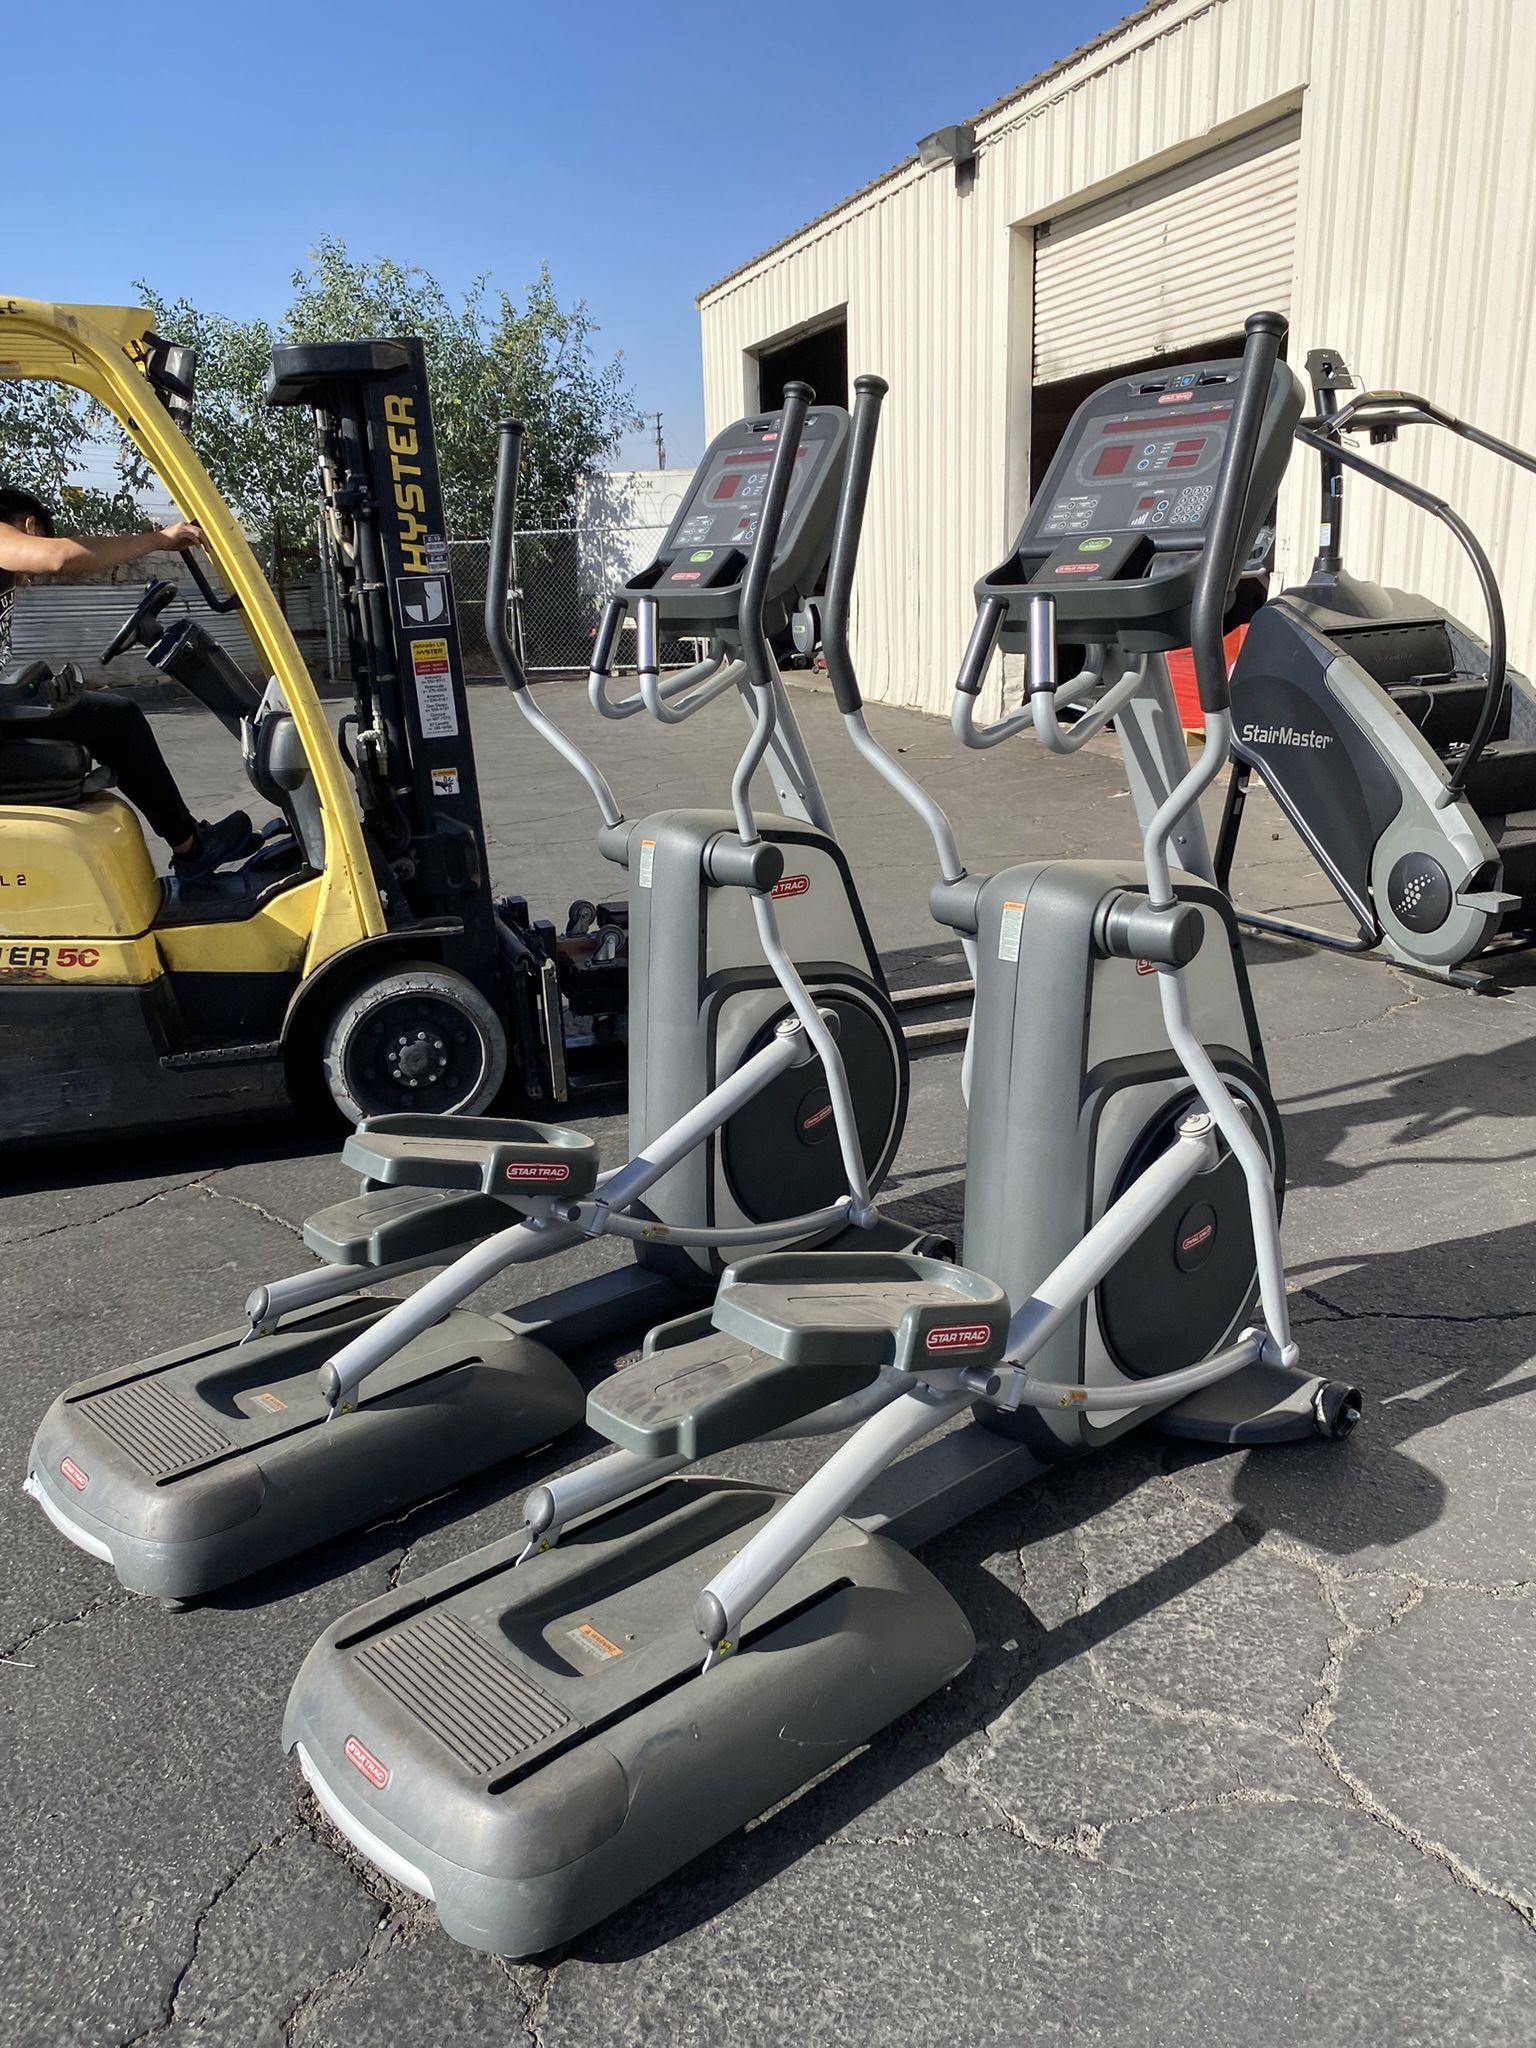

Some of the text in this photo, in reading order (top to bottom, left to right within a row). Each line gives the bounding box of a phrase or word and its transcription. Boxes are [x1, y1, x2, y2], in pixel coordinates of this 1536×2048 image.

[384, 395, 429, 574] HYSTER
[1242, 724, 1330, 749] StairMaster
[16, 874, 27, 886] 2
[780, 880, 805, 892] TRAC
[509, 1168, 565, 1176] STAR TRAC
[928, 1331, 986, 1344] STAR TRAC
[348, 1741, 385, 1781] STAR TRAC
